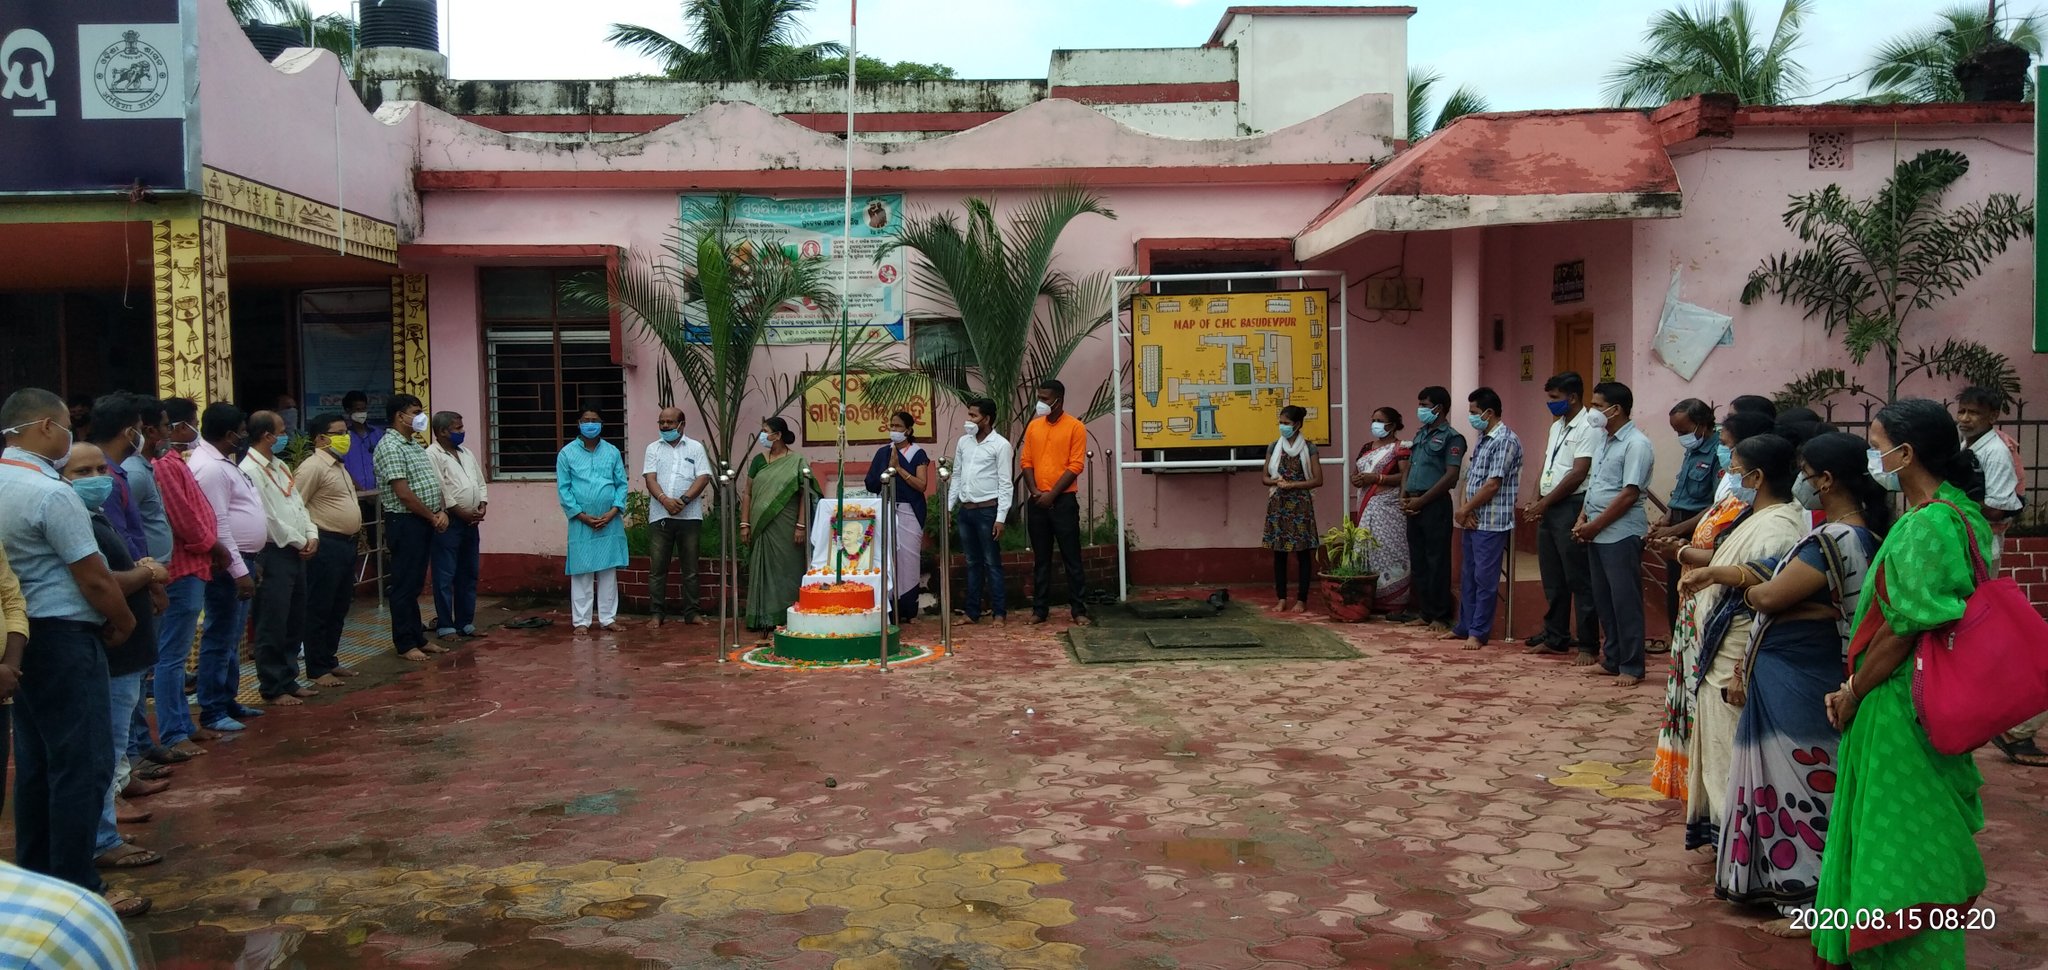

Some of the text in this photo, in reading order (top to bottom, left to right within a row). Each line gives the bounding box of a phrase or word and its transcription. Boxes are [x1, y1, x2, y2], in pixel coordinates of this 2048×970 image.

[1174, 319, 1196, 330] MAP
[1200, 319, 1211, 329] OF
[1240, 317, 1297, 328] BASUDEVPUR
